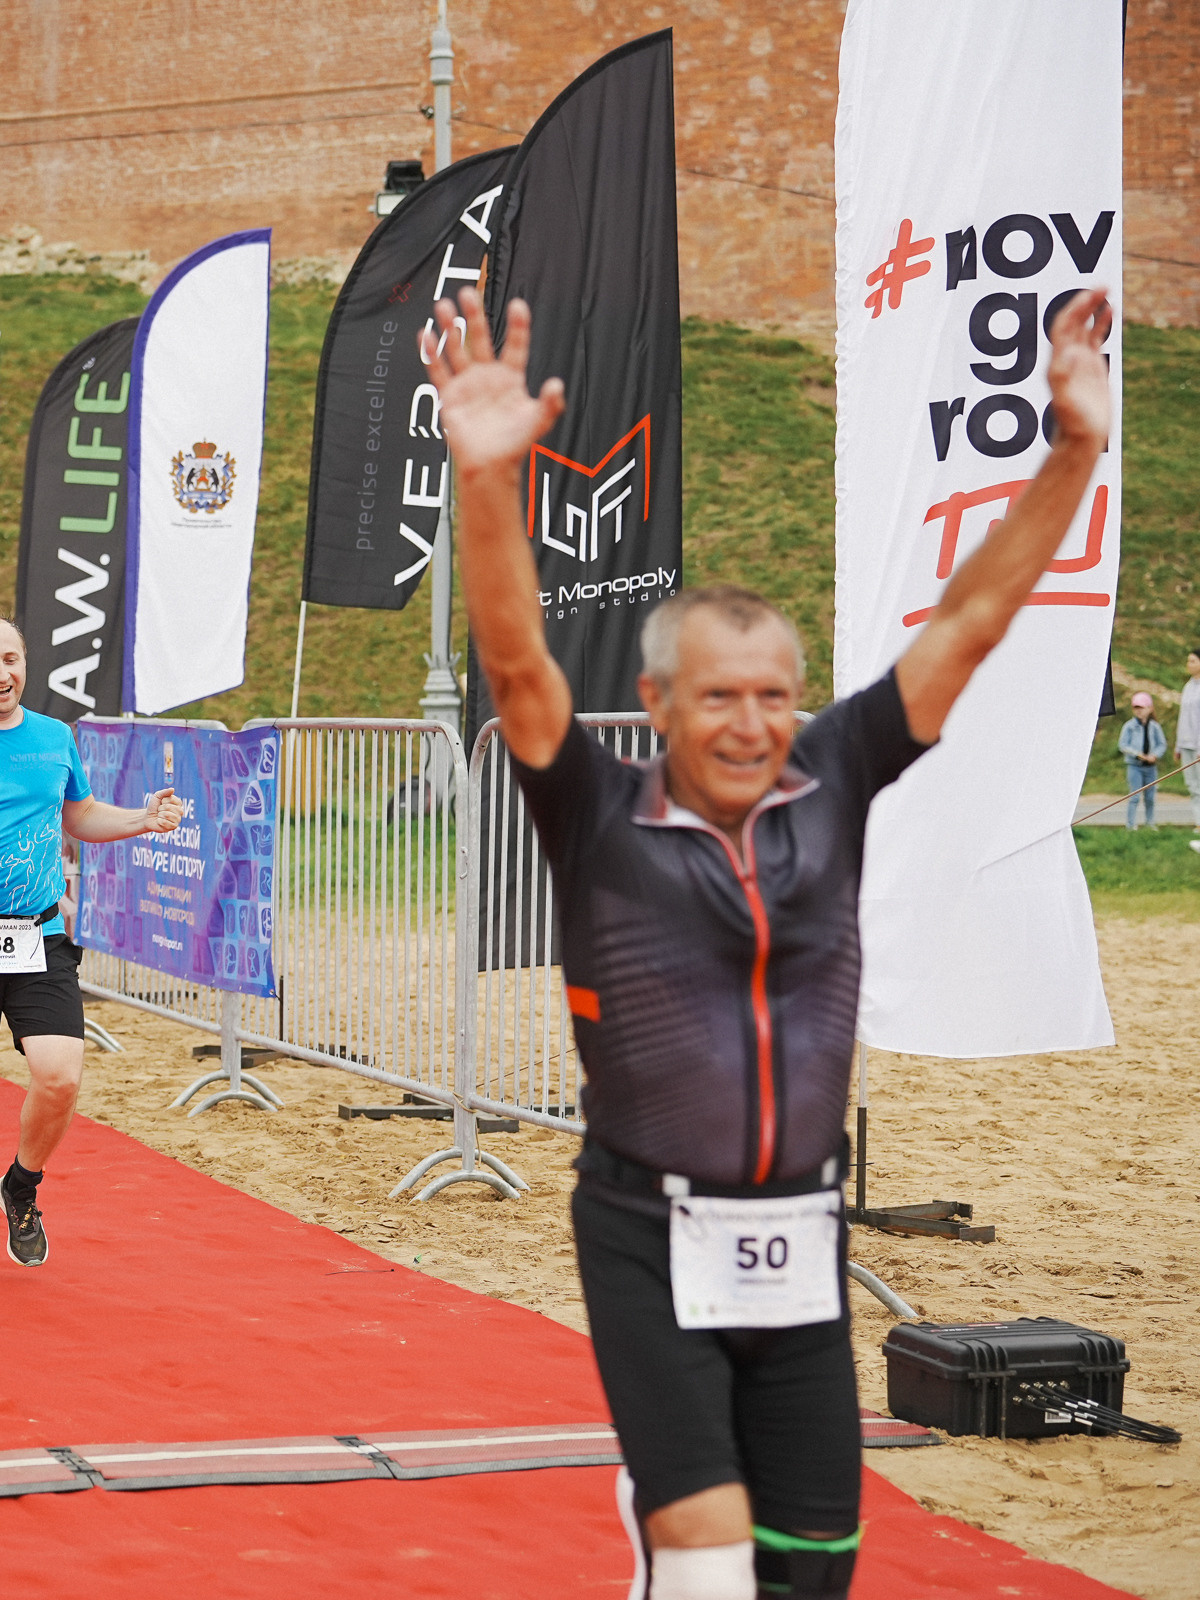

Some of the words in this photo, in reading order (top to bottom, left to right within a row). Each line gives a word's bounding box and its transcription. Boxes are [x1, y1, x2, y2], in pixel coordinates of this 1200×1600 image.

[365, 319, 399, 453] excellence
[356, 462, 380, 552] precise
[559, 566, 677, 606] Monopoly
[599, 588, 677, 610] studio
[737, 1236, 789, 1270] 50
